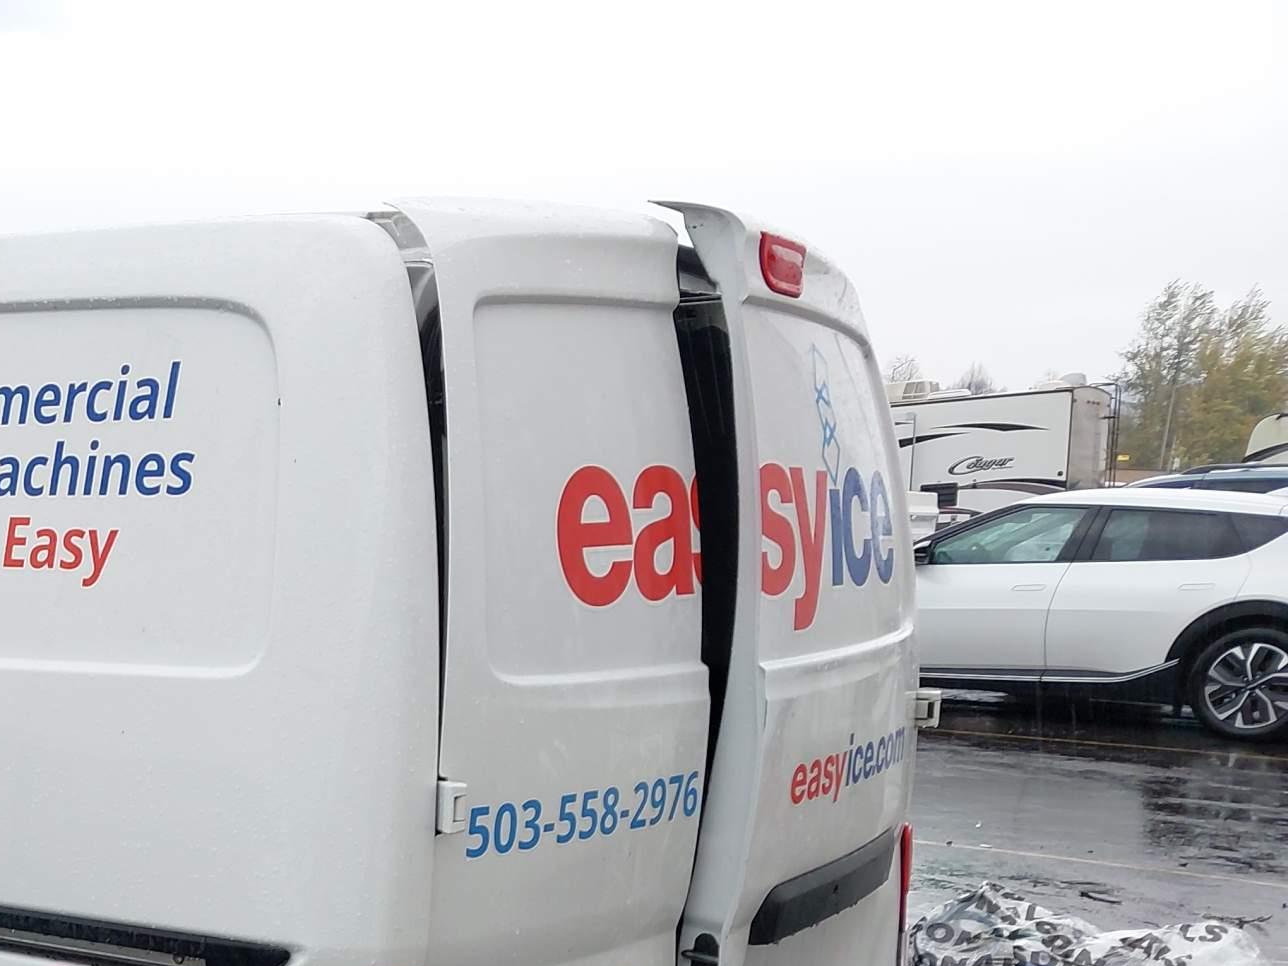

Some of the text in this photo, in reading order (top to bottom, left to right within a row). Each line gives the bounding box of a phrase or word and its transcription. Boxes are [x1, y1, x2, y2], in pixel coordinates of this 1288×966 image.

[948, 455, 1014, 475] Cougar
[2, 516, 120, 588] Easy
[790, 726, 905, 805] easyice.com
[465, 770, 699, 858] 503-558-2976
